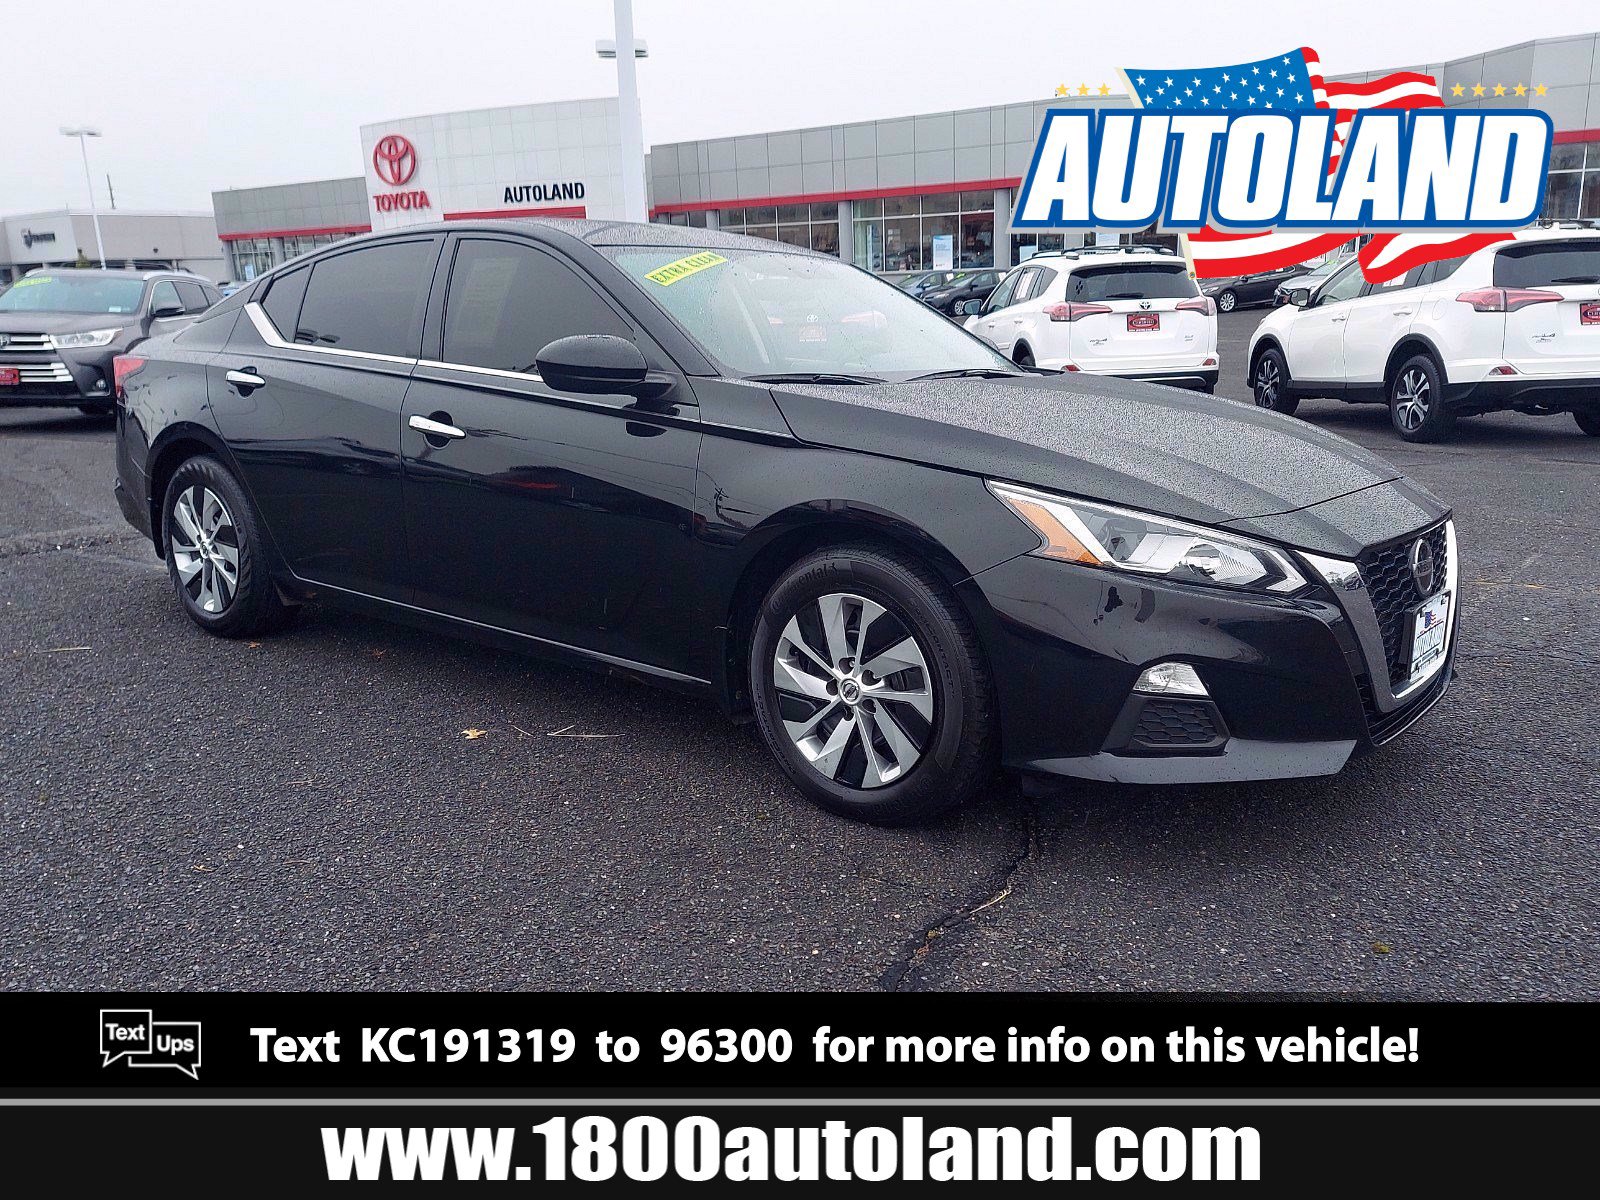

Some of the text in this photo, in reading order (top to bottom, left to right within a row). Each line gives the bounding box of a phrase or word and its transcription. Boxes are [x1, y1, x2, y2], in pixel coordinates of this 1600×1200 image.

[373, 190, 431, 213] TOYOTA
[503, 182, 585, 203] AUTOLAND
[768, 562, 829, 614] Cental
